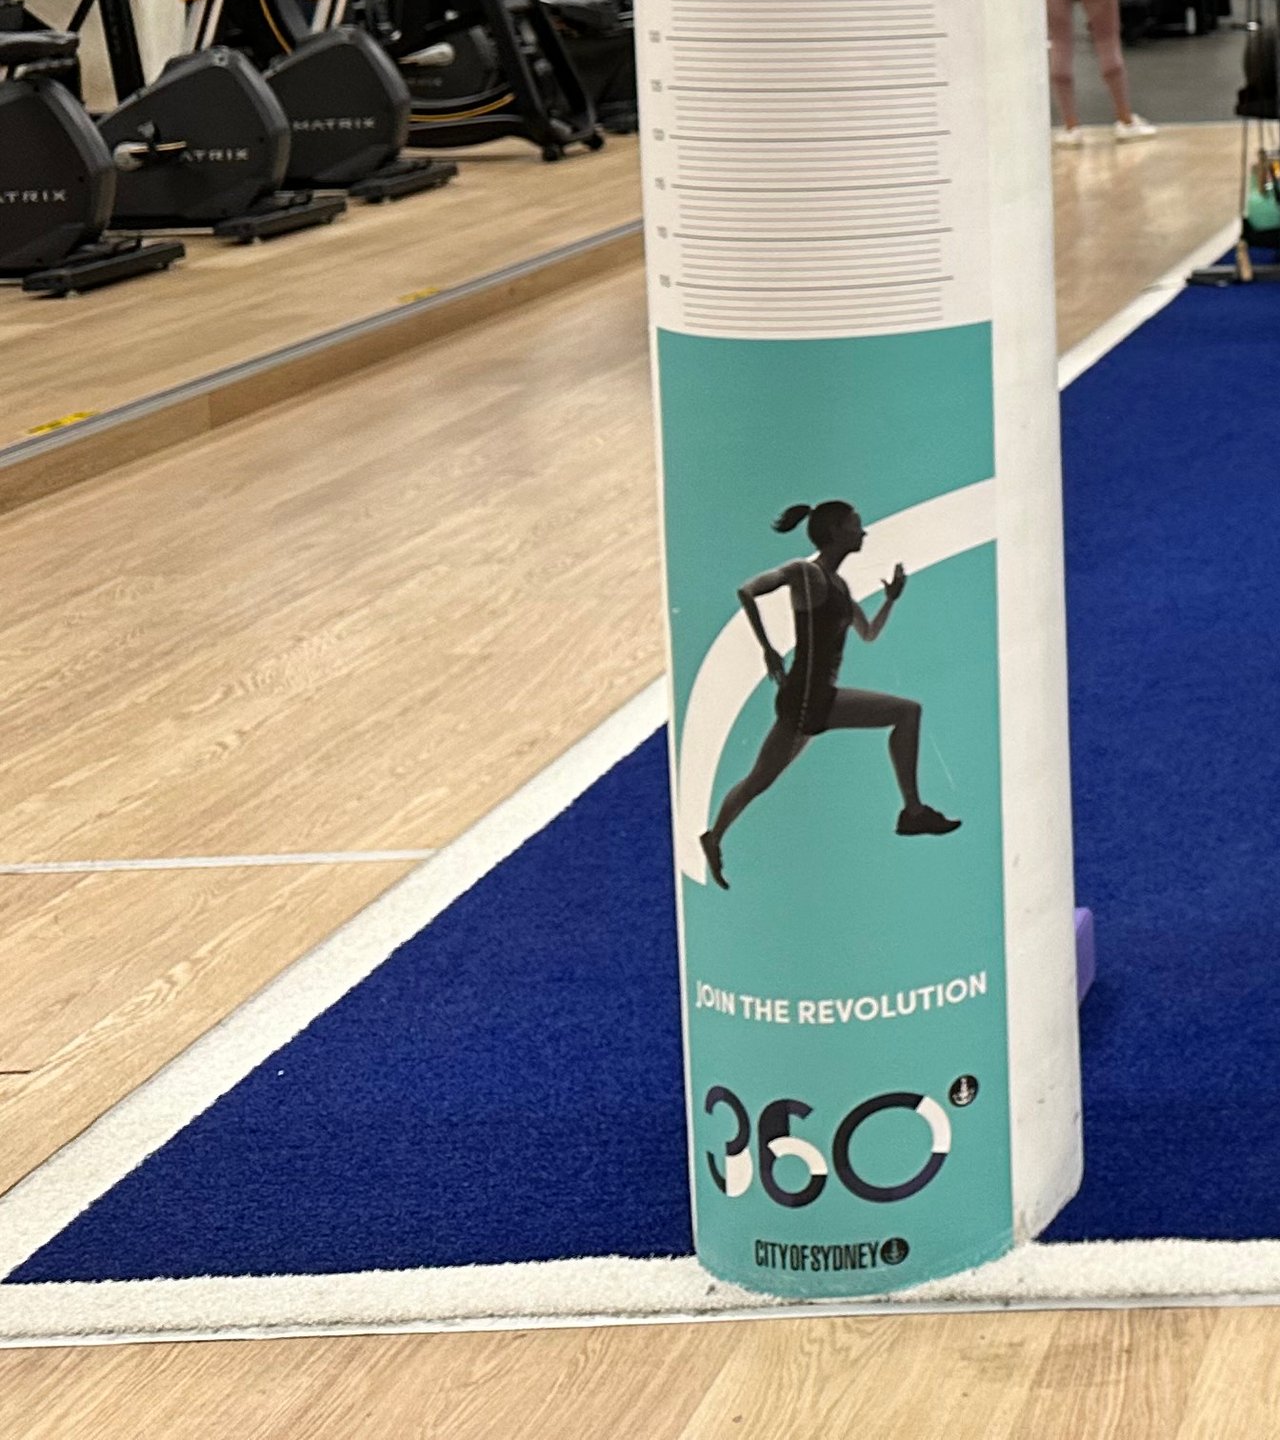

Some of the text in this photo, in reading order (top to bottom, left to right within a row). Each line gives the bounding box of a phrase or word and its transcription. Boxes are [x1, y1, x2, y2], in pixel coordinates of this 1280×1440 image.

[292, 117, 376, 132] MATRIX
[178, 147, 250, 162] ATRIX
[0, 189, 67, 204] TRIX
[695, 970, 988, 1025] JOIN THE REVOLUTION
